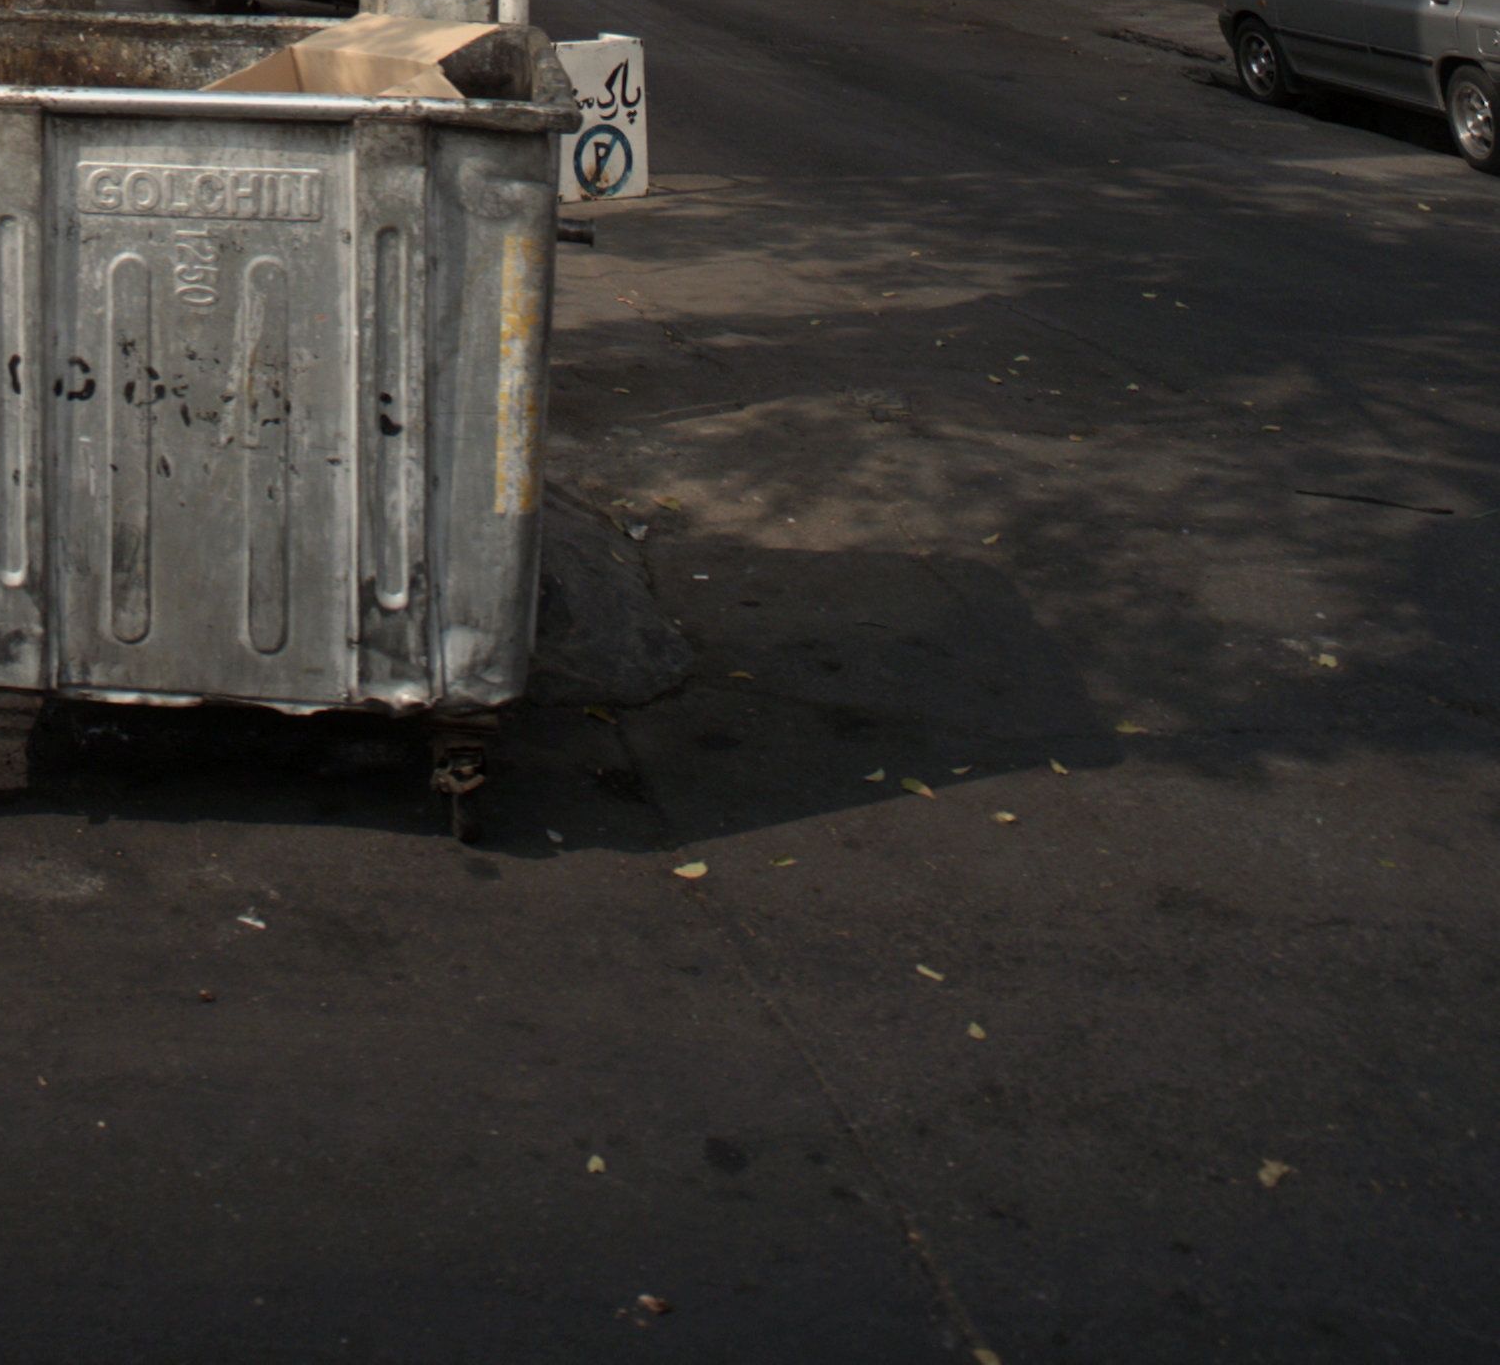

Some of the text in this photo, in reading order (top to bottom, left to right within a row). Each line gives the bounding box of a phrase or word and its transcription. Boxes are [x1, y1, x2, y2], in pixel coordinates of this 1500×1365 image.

[597, 58, 642, 125] پارک
[87, 167, 313, 217] GOLCHIN
[174, 229, 220, 307] 1250
